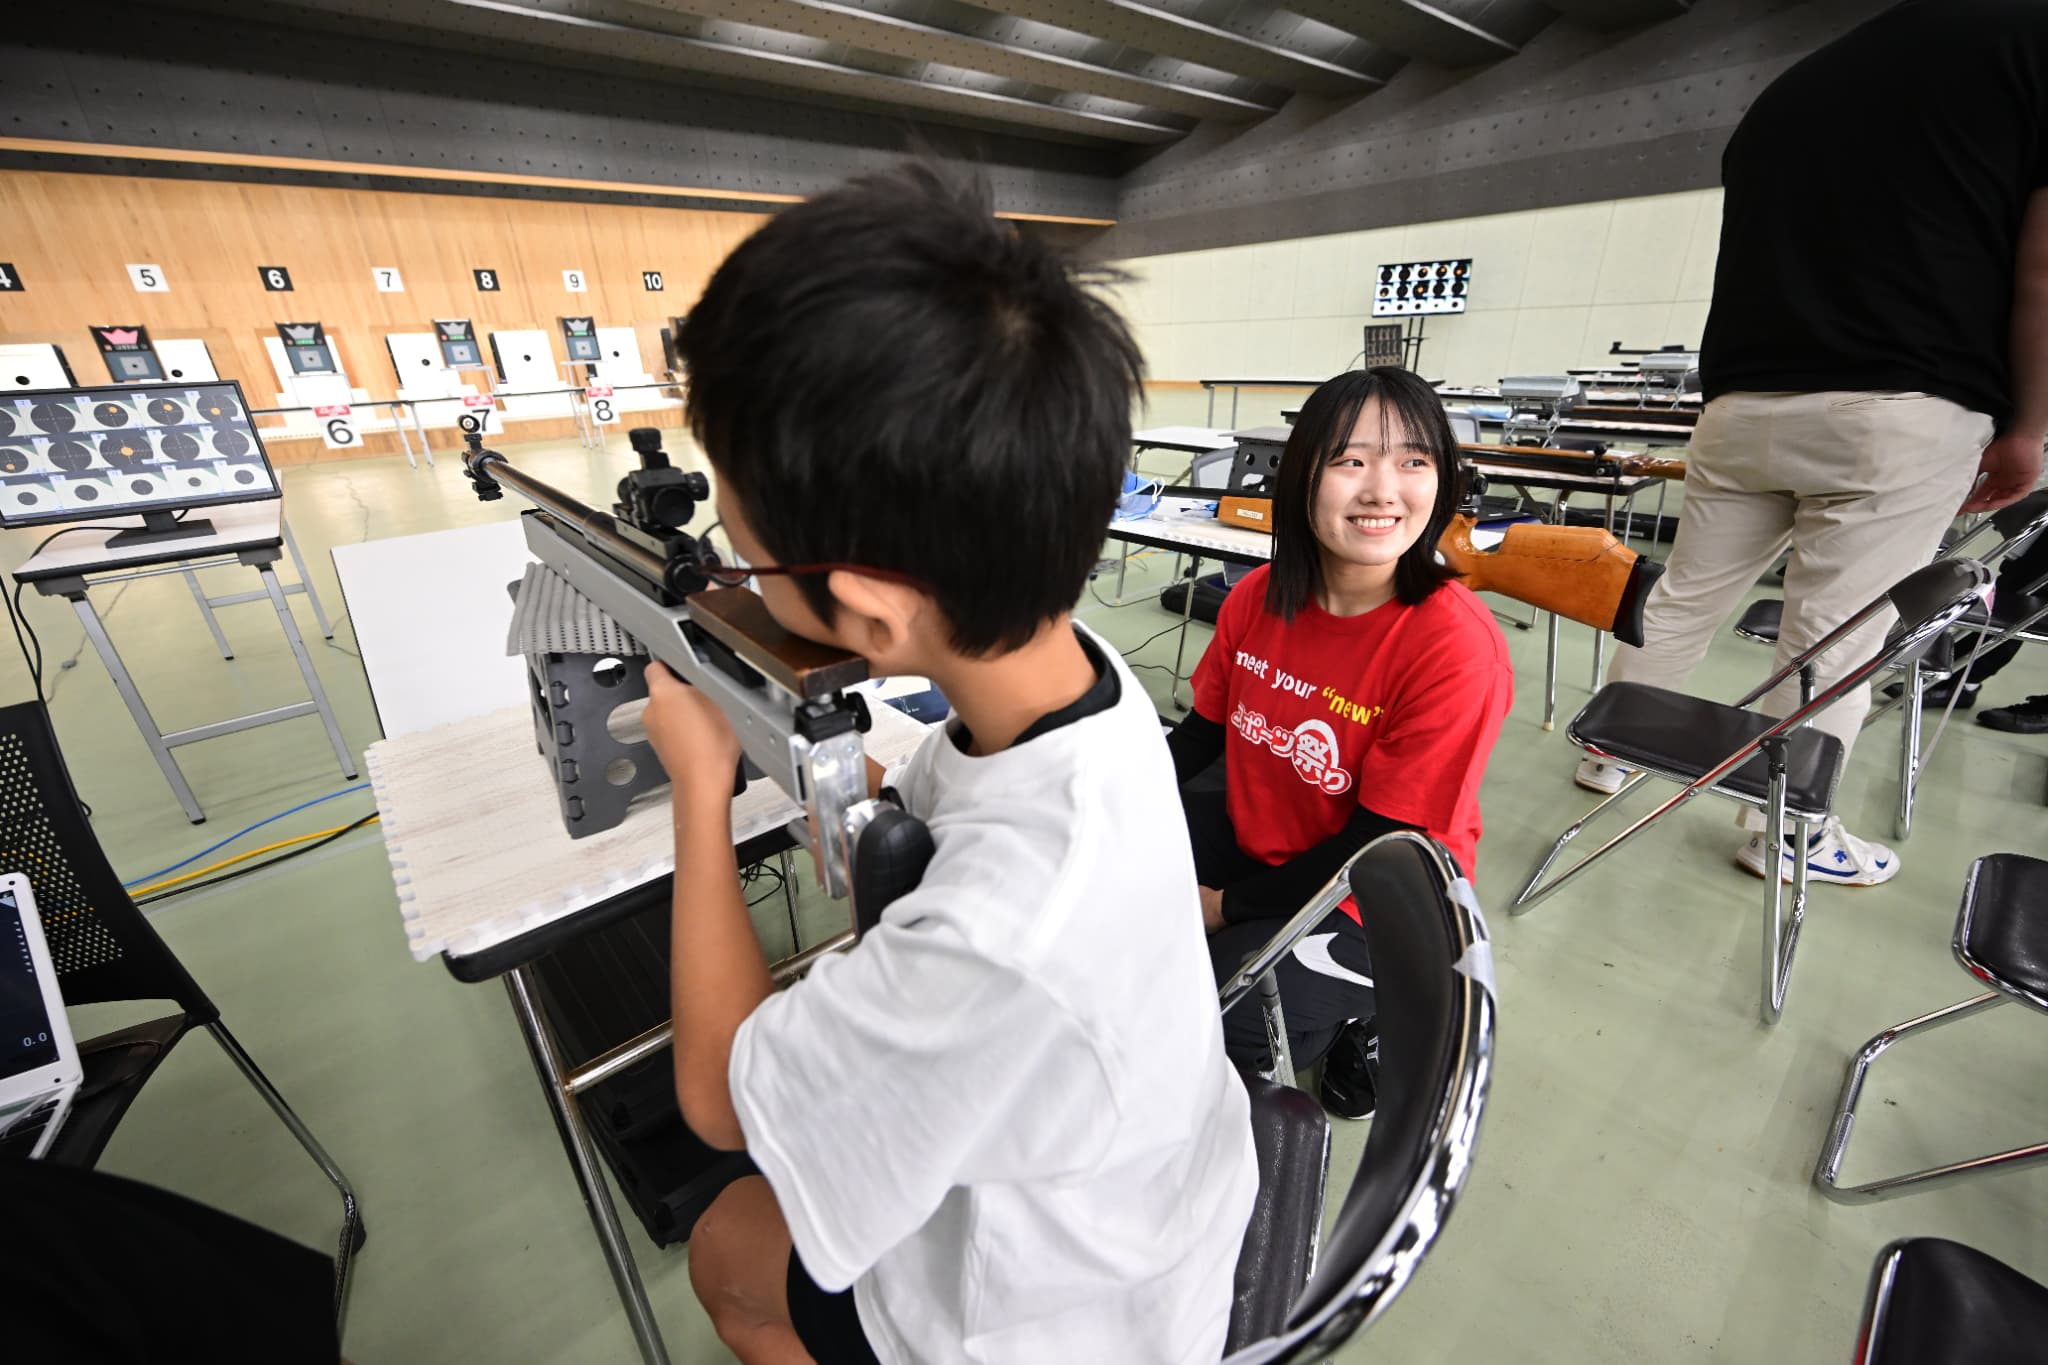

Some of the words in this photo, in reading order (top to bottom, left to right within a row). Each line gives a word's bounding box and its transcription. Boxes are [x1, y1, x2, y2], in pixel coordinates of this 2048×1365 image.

[140, 269, 156, 287] 5
[267, 269, 285, 289] 6
[380, 271, 391, 288] 7
[480, 271, 493, 289] 8
[569, 273, 580, 288] 9
[644, 273, 662, 289] 10
[595, 399, 614, 421] 8
[472, 408, 490, 432] 7
[327, 419, 354, 445] 6
[1271, 668, 1318, 700] your
[23, 1032, 48, 1047] 0.0
